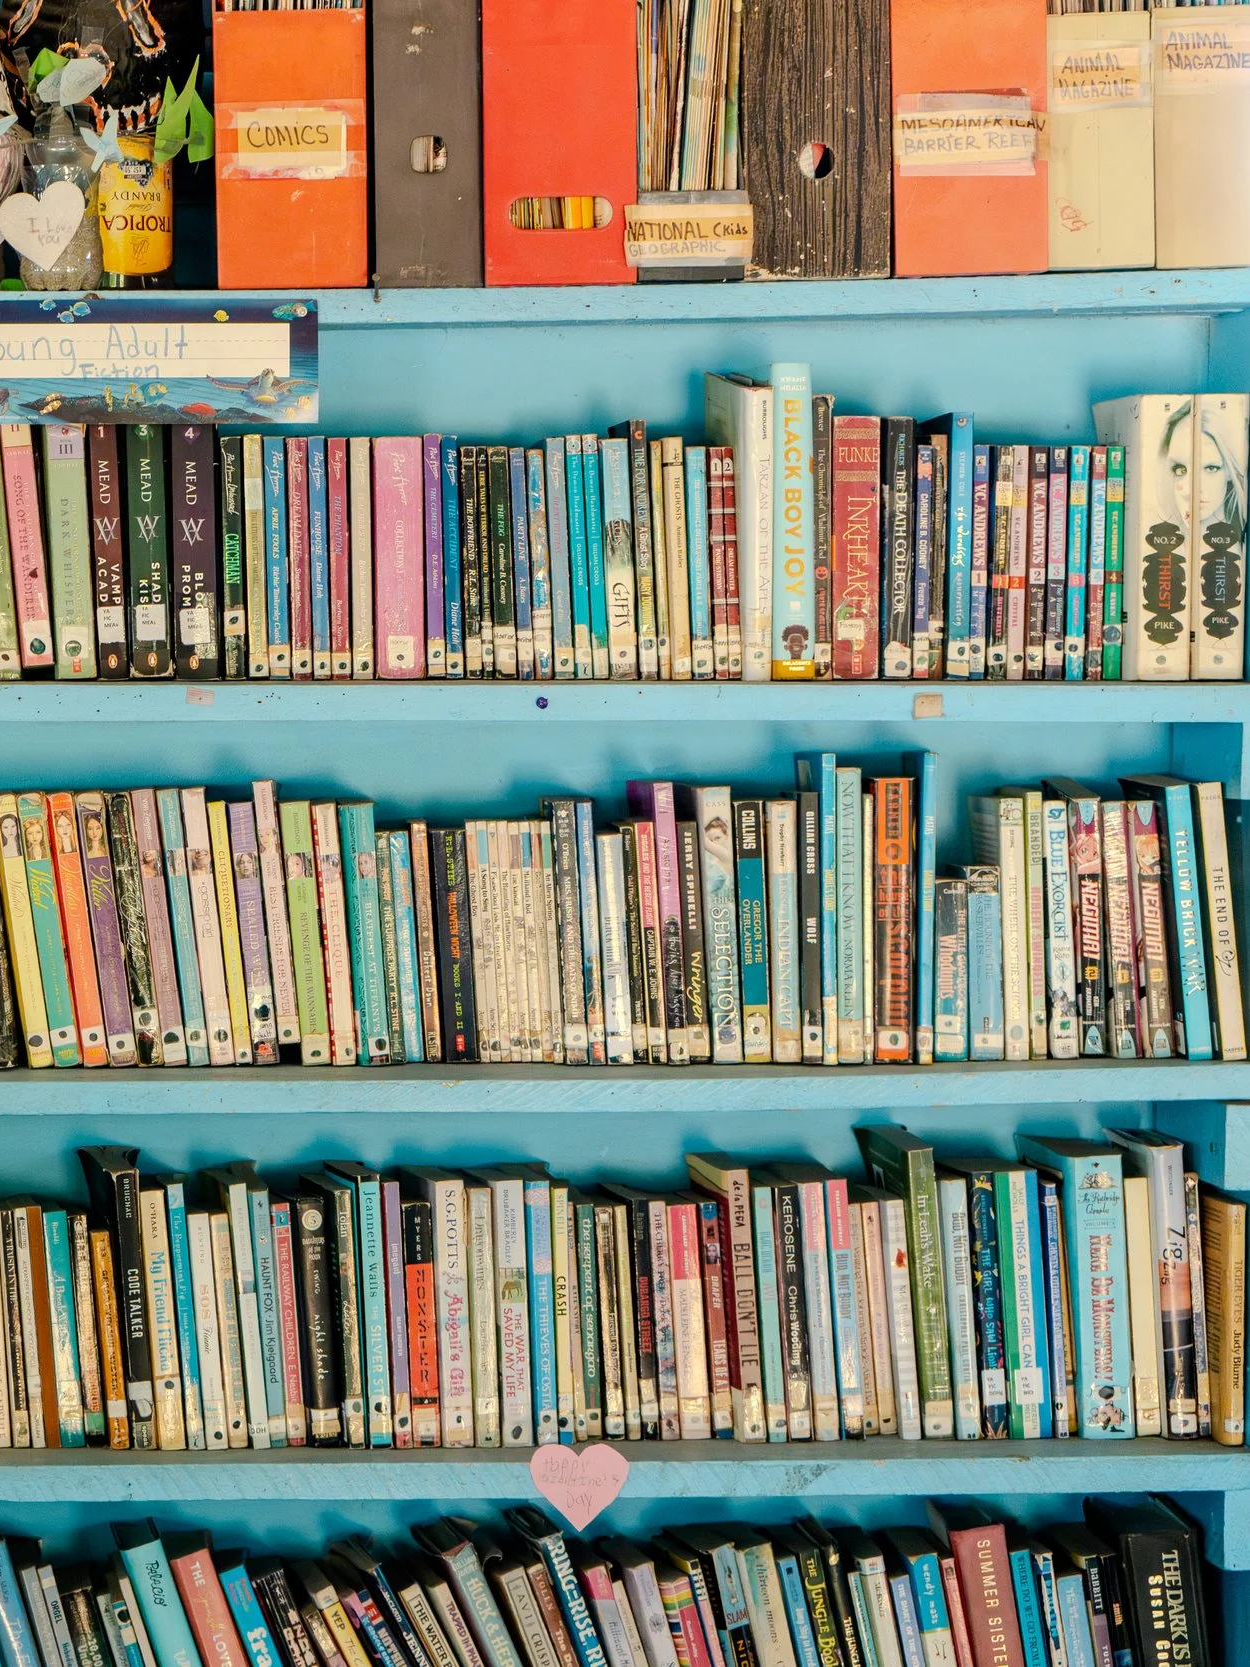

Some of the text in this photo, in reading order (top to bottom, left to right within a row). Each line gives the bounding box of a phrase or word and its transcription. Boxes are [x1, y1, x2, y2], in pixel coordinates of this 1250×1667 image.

[1166, 31, 1233, 50] ANIMAL
[1062, 52, 1124, 74] ANIMAL
[1168, 52, 1250, 71] MAGAZINE
[246, 121, 330, 149] COMICS
[904, 131, 1032, 155] BARRIER REEF
[111, 191, 160, 200] BRANDY
[102, 215, 171, 232] TROPICA
[628, 221, 708, 242] NATIONAL
[629, 241, 726, 257] GEOGRAPHIC
[106, 324, 188, 359] Adult
[79, 363, 159, 381] Fiction
[839, 445, 879, 465] FUNKE
[98, 460, 111, 504] MEAD
[140, 458, 151, 503] MEAD
[186, 461, 197, 505] MEAD
[784, 399, 806, 597] BLACK BOY JOY
[270, 507, 278, 531] APRIL
[225, 533, 240, 585] CATCHMAN
[893, 471, 906, 615] THE DEATH COLLECTOR
[1153, 536, 1177, 544] NO. 2
[1157, 555, 1172, 610] THIRST
[1213, 557, 1226, 603] THIRST
[1155, 621, 1174, 630] PIKE
[1212, 616, 1230, 625] PIKE
[741, 810, 756, 849] COLLINS
[217, 850, 233, 929] CLIQUETIONARY
[684, 831, 696, 929] JERRY SPINELLI
[1174, 830, 1197, 948] YELLOW BRICK
[741, 899, 751, 965] OVERLANDER
[752, 900, 761, 941] GREGOR
[807, 918, 816, 944] WOLF
[686, 951, 704, 1025] Wringer
[444, 1189, 459, 1268] S.G.POTTS
[782, 1195, 797, 1273] KEROSENE
[1014, 1219, 1026, 1262] THINGS
[150, 1252, 165, 1274] My
[128, 1268, 143, 1339] CODE TALKER
[153, 1279, 170, 1324] Friend
[557, 1276, 567, 1317] CRASH
[1232, 1329, 1242, 1389] Judy Blume
[977, 1539, 998, 1609] SUMMER
[331, 1612, 346, 1631] YEP
[1148, 1575, 1166, 1629] SUSAN
